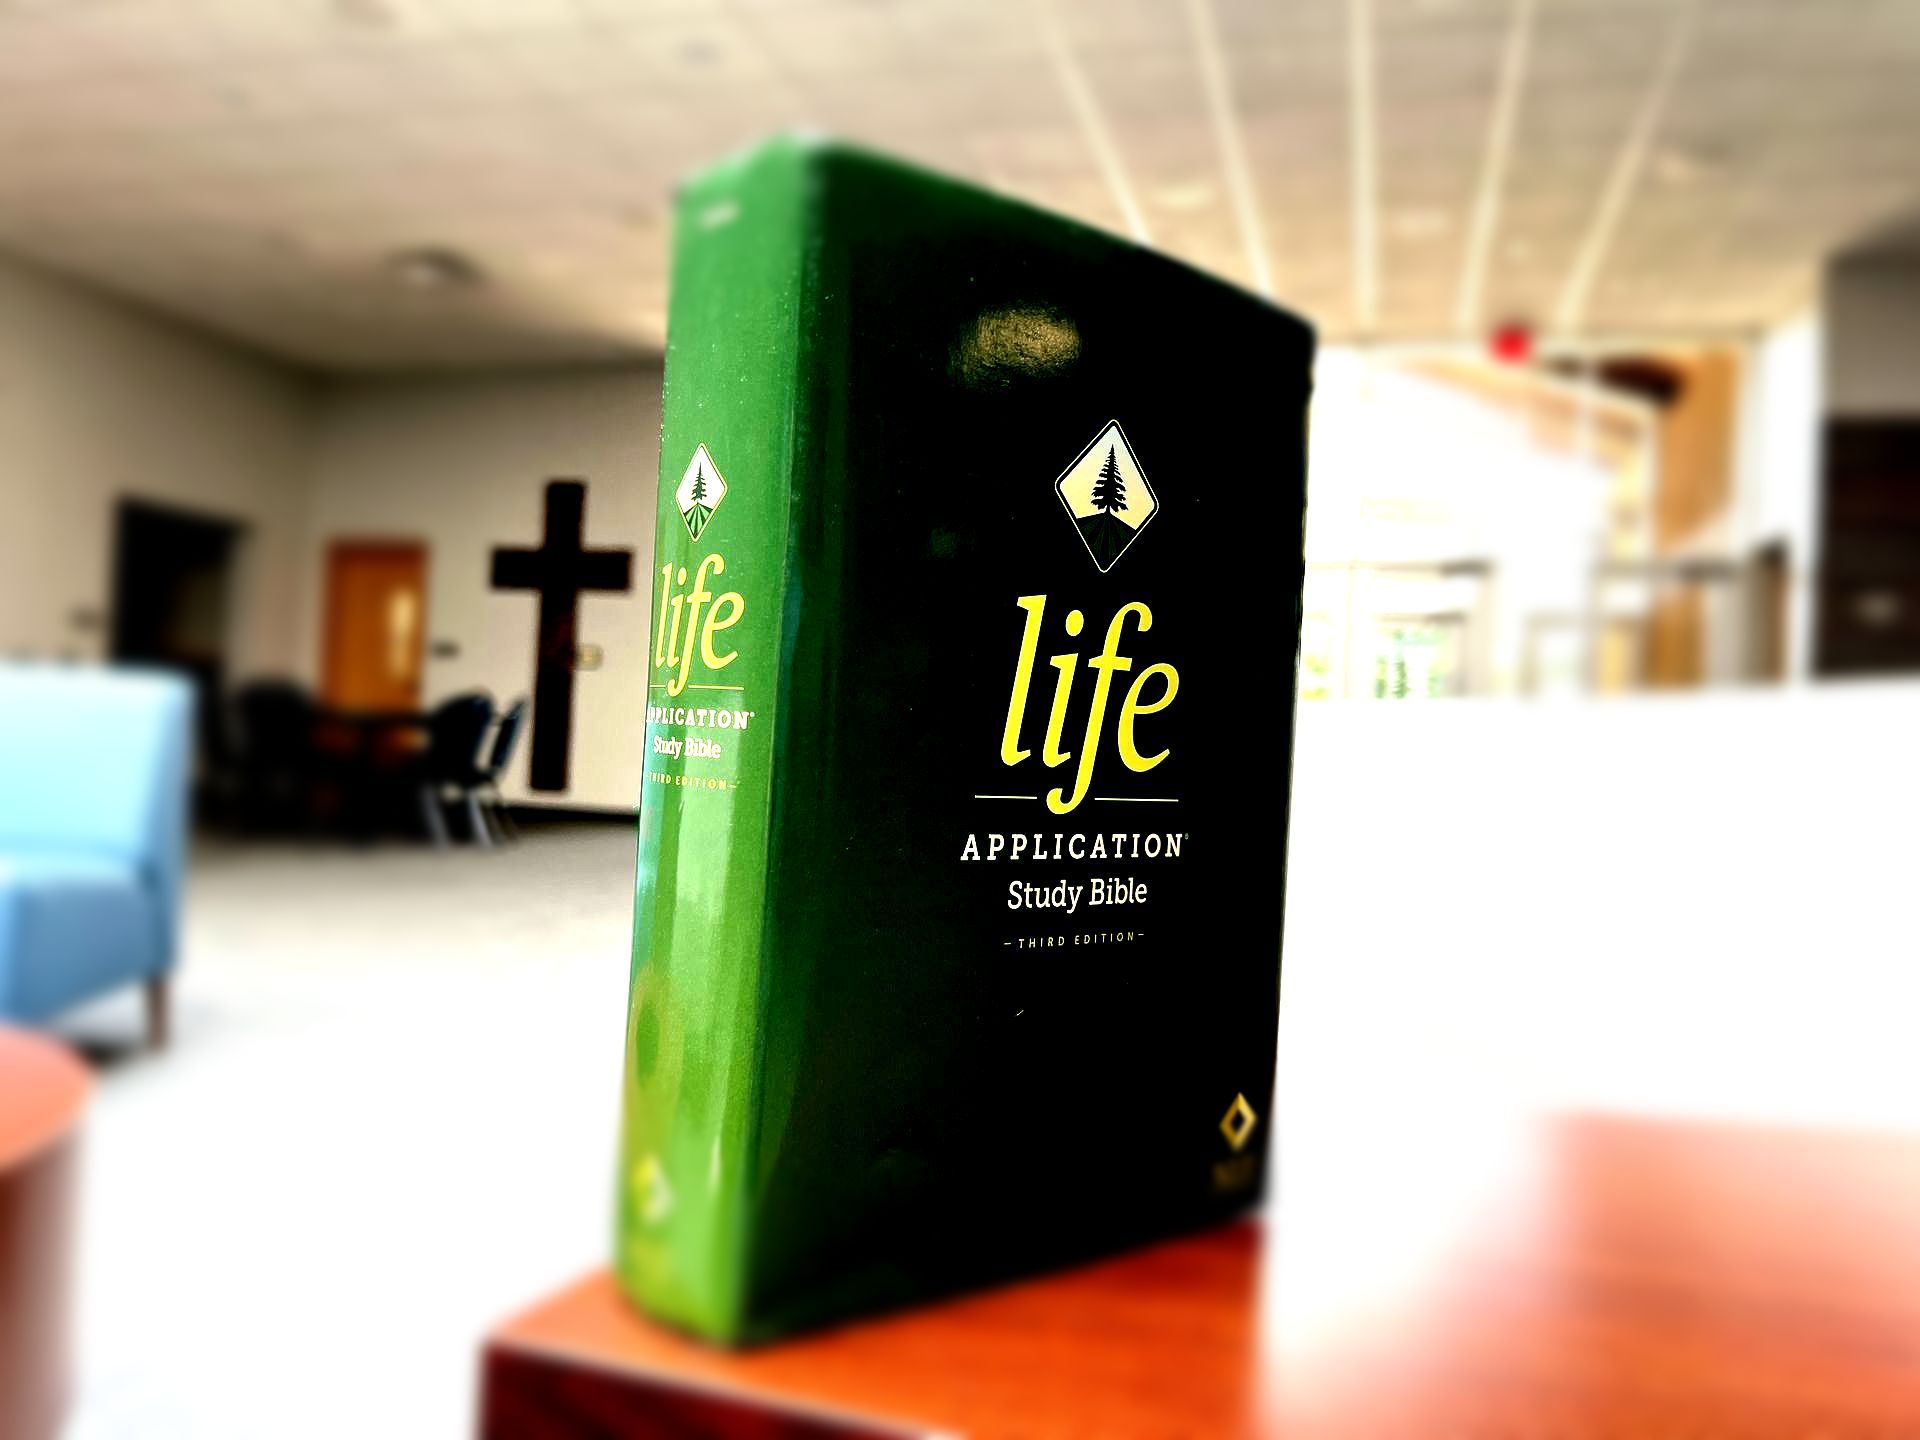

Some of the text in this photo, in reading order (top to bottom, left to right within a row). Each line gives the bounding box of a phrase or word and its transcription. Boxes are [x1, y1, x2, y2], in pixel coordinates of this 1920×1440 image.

[654, 553, 745, 697] life
[1001, 594, 1180, 814] life
[653, 735, 721, 760] Study Bible
[960, 833, 1183, 861] APPLICATION
[1007, 877, 1147, 914] Study Bible
